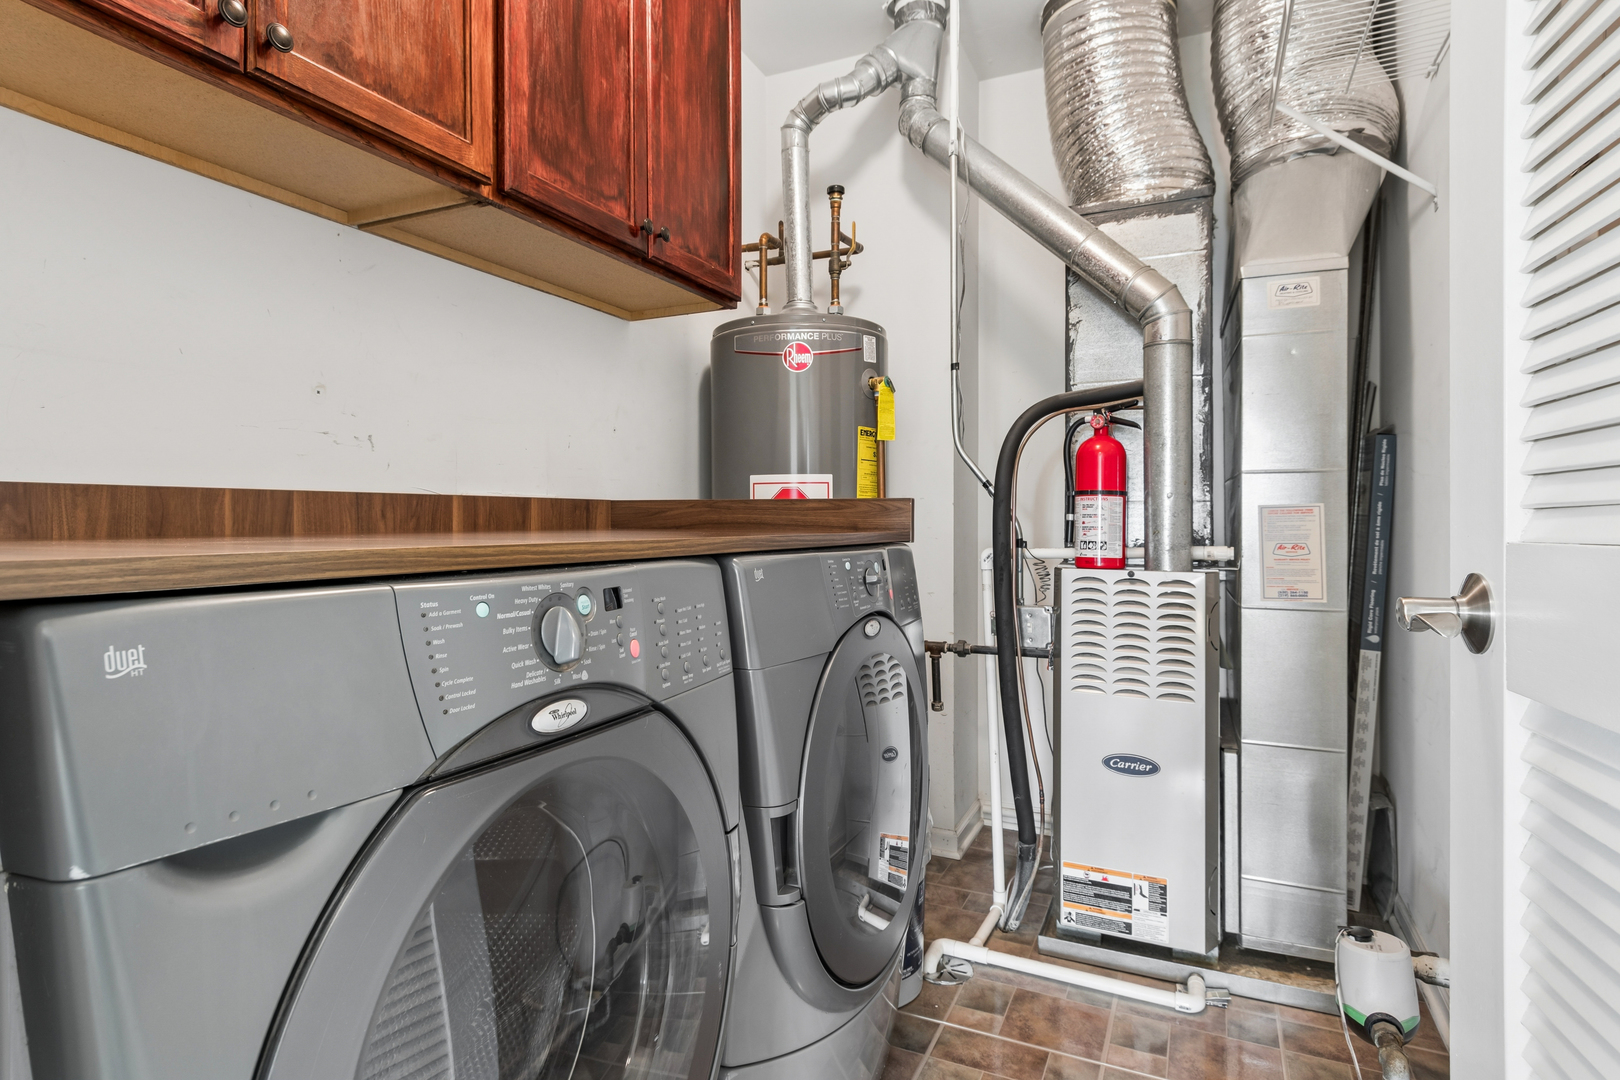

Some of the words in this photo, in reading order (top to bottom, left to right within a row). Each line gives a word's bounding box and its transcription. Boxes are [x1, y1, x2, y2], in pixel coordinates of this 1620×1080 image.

[754, 332, 819, 342] PERFORMANCE
[821, 332, 842, 340] PLUS
[786, 343, 812, 368] Rheem
[497, 609, 531, 619] Normal/Casual
[104, 644, 147, 672] duet
[130, 668, 145, 677] HT
[526, 670, 543, 678] Delicate
[442, 679, 453, 687] Cycle
[454, 676, 474, 684] Complete
[511, 680, 523, 689] Hand
[524, 676, 547, 686] Washables
[445, 692, 461, 700] Control
[462, 689, 476, 697] Locked
[550, 705, 577, 722] Whirlpool
[1109, 758, 1153, 772] Carrier
